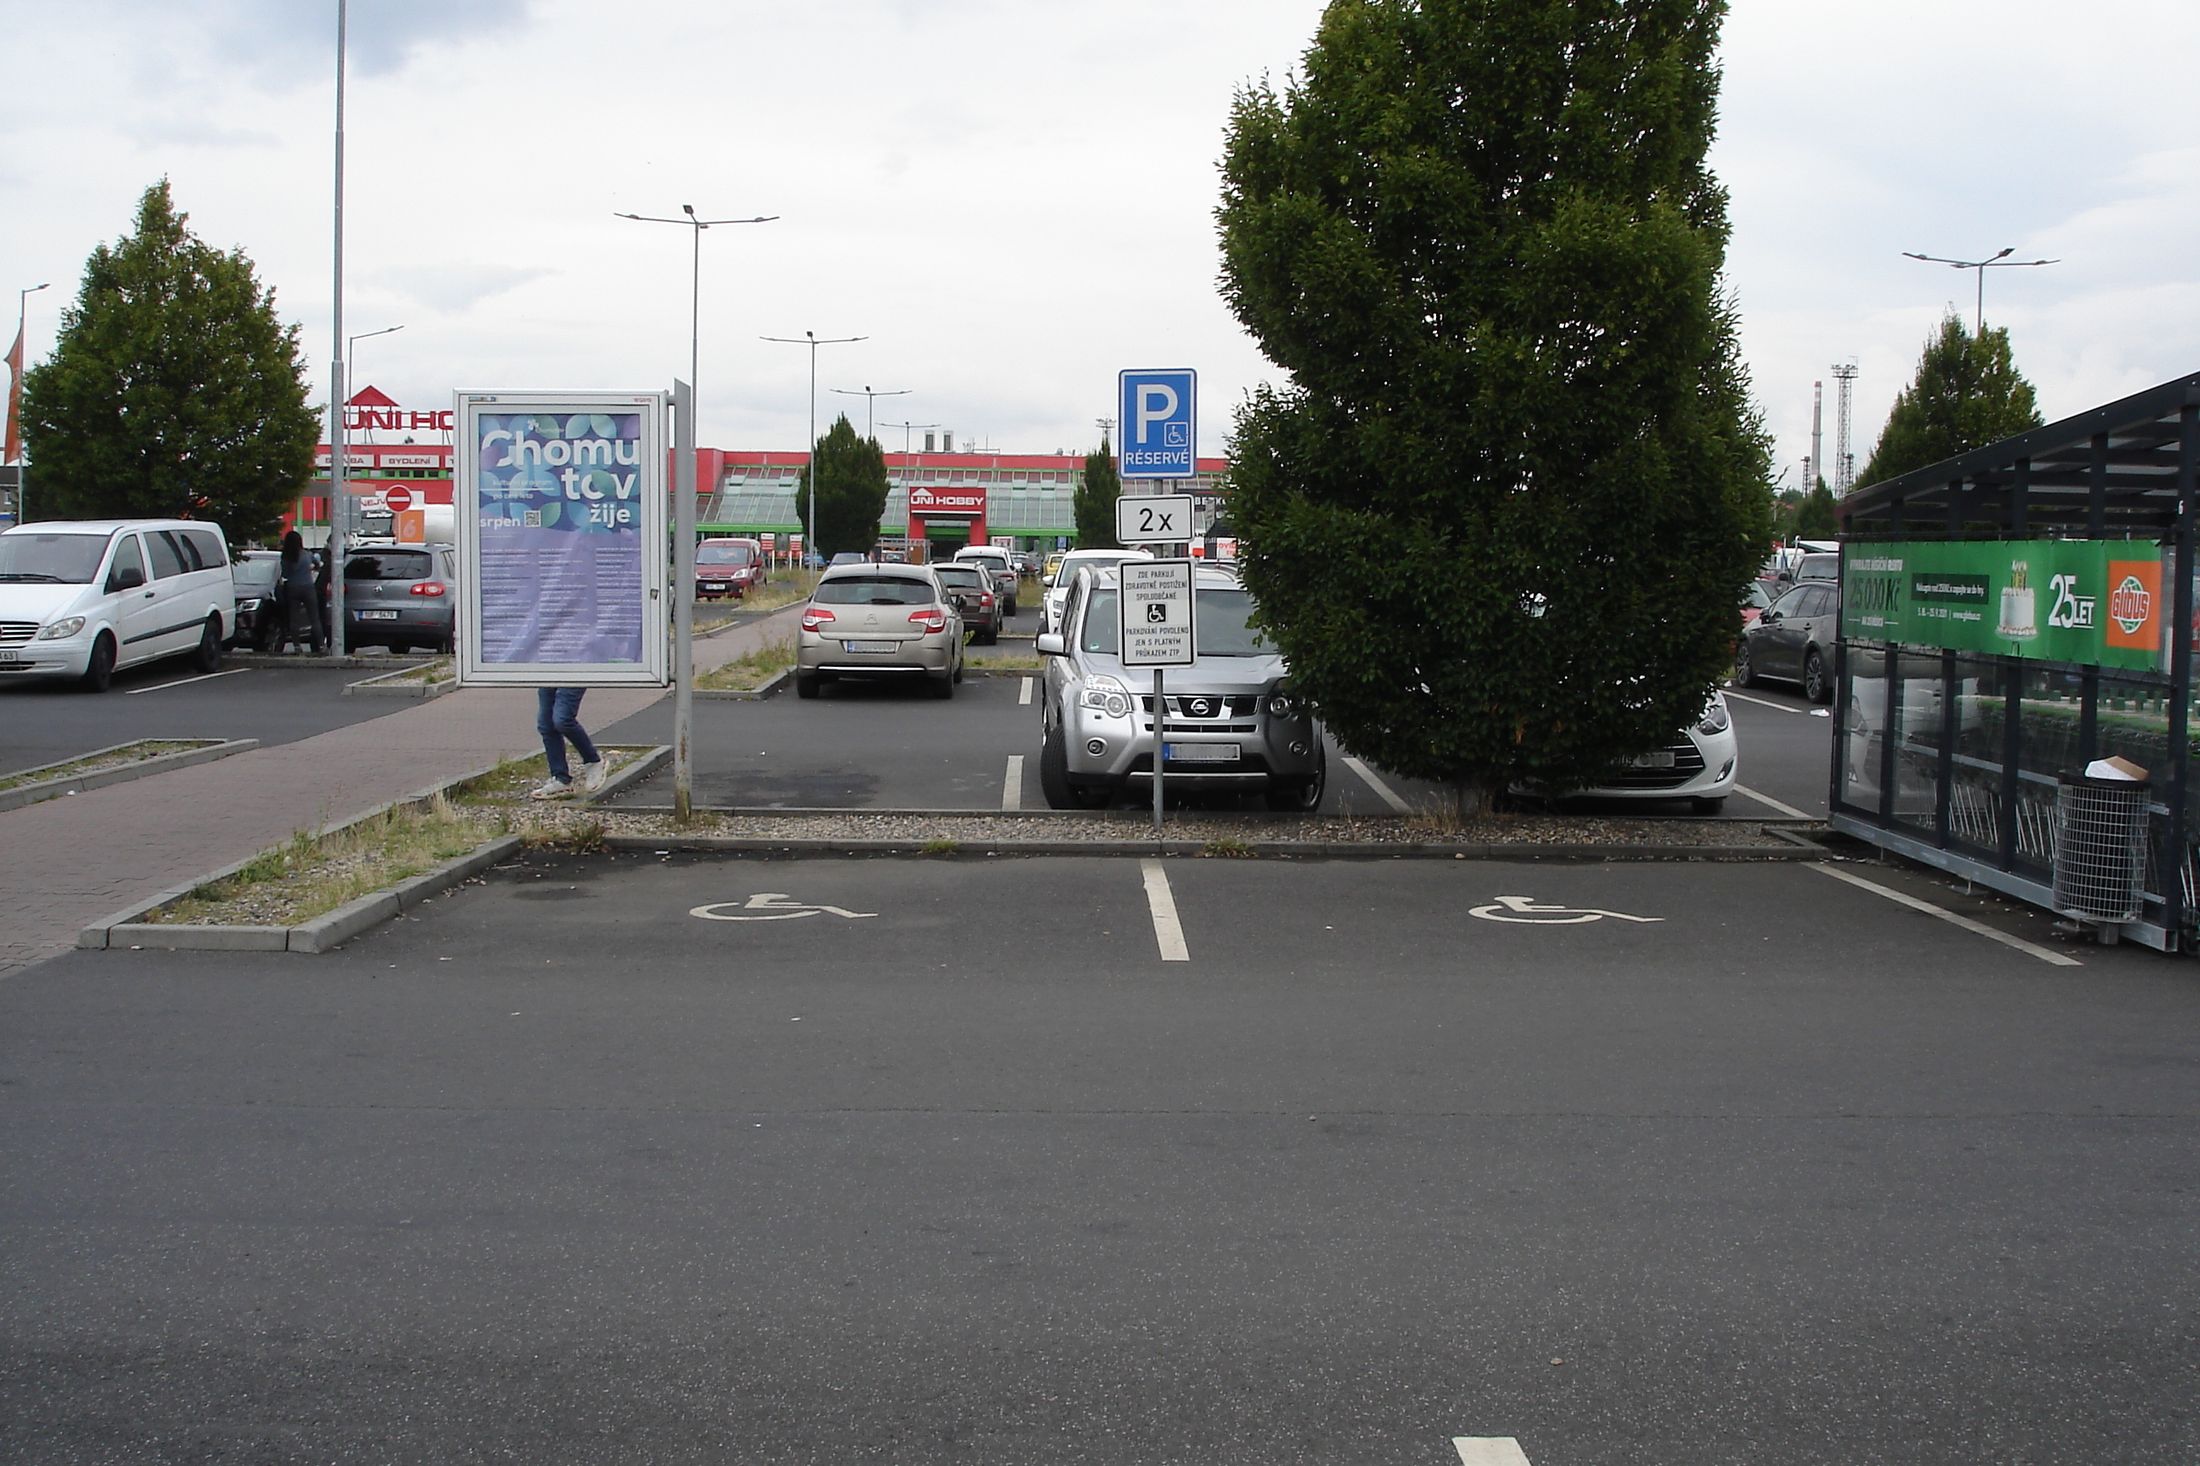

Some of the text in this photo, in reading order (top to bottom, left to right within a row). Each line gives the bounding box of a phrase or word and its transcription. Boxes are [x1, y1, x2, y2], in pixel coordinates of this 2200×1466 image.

[1136, 384, 1178, 444] P
[481, 430, 640, 466] Chomu
[388, 456, 431, 465] BYDLENÍ
[1125, 449, 1190, 465] RÉSERVÉ
[911, 496, 984, 506] UNI HOBBY
[590, 502, 631, 529] žije
[1139, 508, 1173, 532] 2 x
[480, 517, 521, 529] srpen
[1138, 570, 1148, 579] ZDE
[2048, 573, 2095, 629] 25 LET
[1159, 626, 1189, 635] POVOLENO
[1135, 638, 1145, 646] JEN
[1154, 637, 1181, 646] PLATNÝM
[1169, 648, 1179, 657] ZTP
